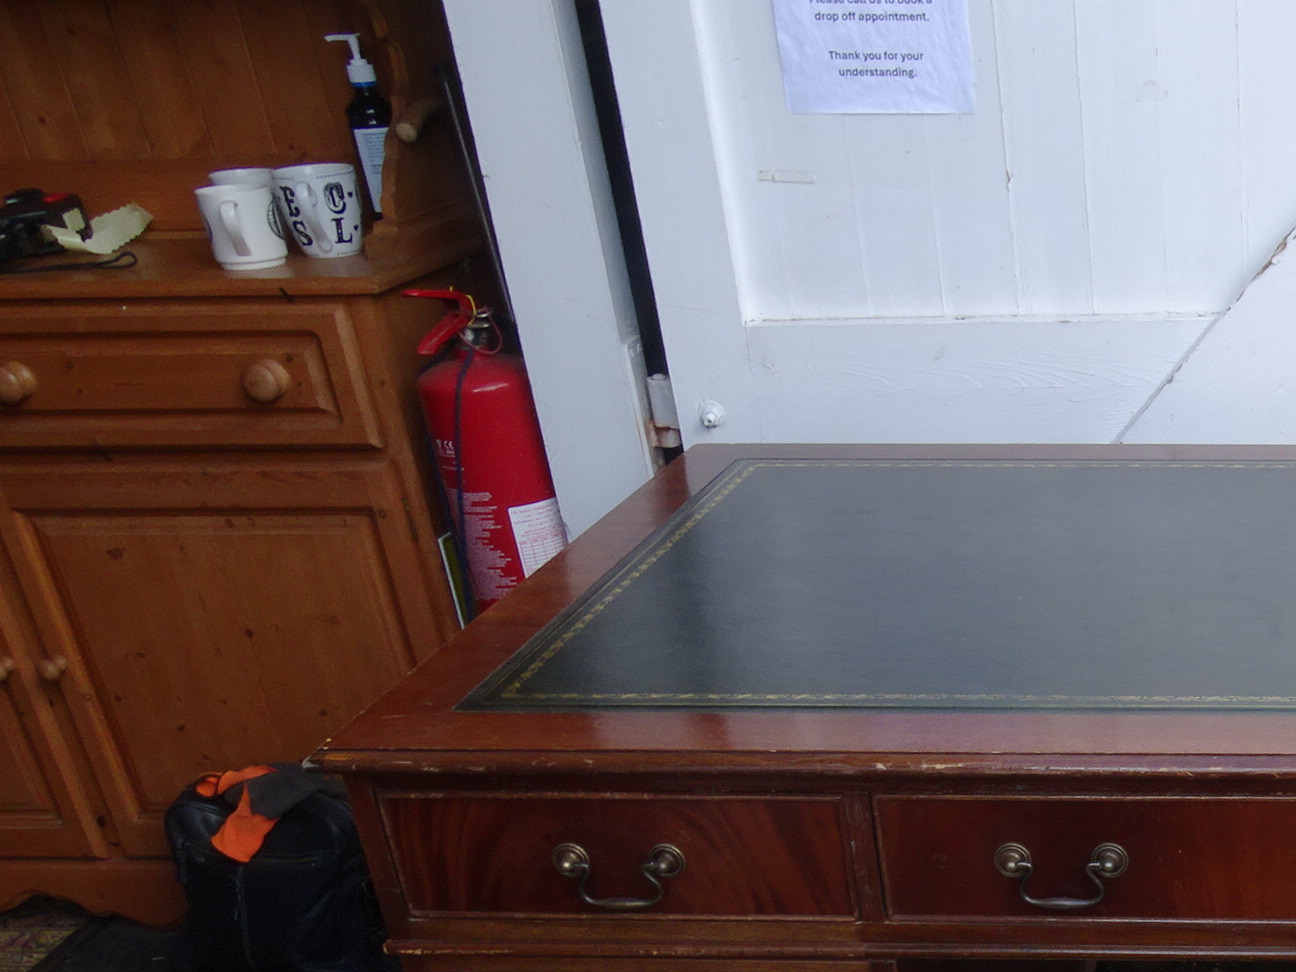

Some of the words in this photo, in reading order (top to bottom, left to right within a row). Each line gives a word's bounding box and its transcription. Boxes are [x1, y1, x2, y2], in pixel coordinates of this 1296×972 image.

[814, 11, 839, 23] drop
[841, 11, 856, 21] off
[858, 11, 930, 23] appointment.
[829, 50, 860, 60] Thank
[862, 52, 881, 62] you
[883, 51, 898, 60] for
[900, 52, 924, 62] your
[838, 68, 917, 79] understanding.
